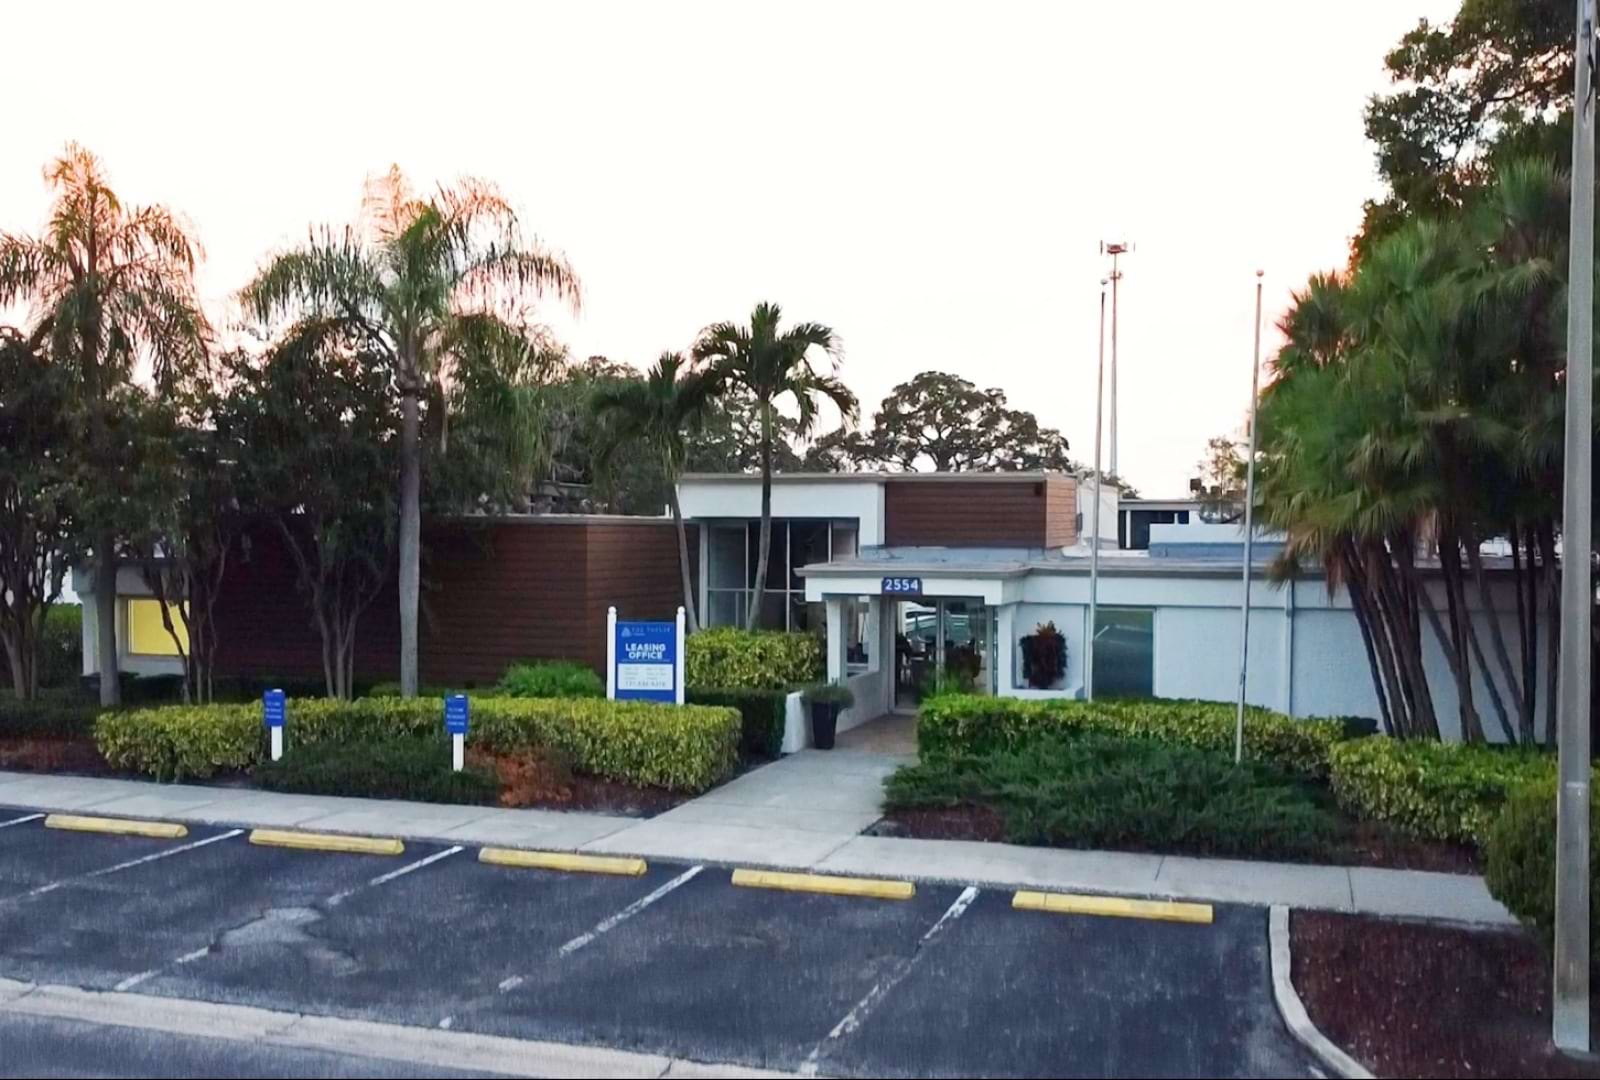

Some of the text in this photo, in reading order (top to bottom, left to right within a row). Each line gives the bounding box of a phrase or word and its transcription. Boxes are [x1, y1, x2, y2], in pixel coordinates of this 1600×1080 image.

[885, 578, 919, 591] 2554
[625, 643, 666, 652] LEASING
[628, 651, 663, 660] OFFICE
